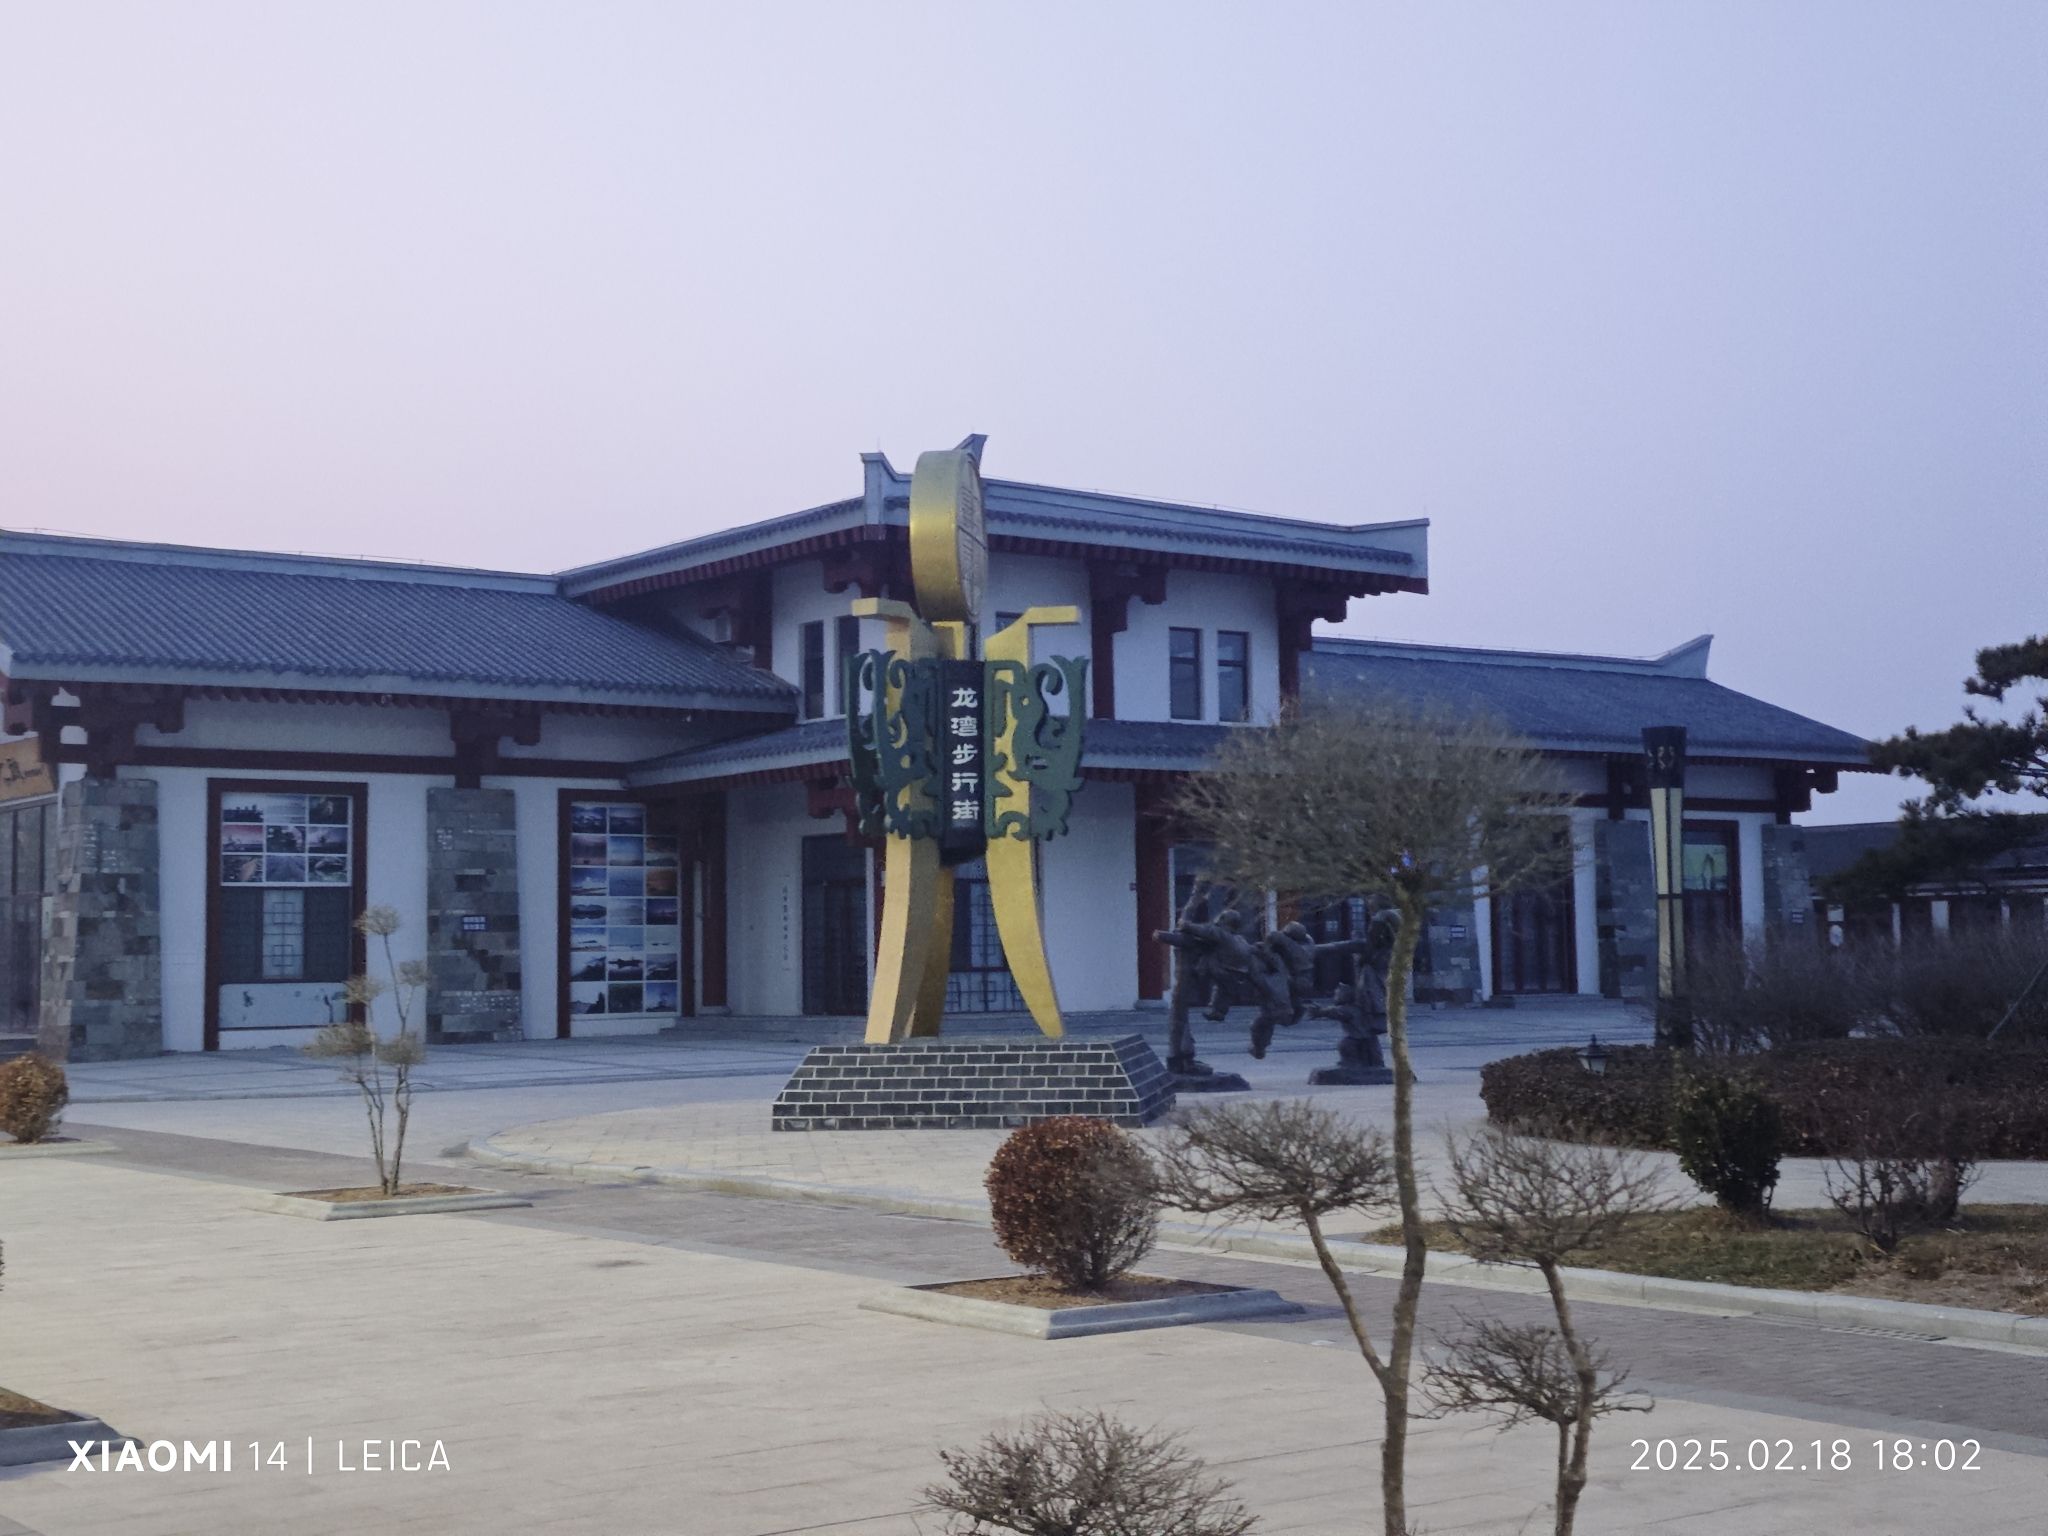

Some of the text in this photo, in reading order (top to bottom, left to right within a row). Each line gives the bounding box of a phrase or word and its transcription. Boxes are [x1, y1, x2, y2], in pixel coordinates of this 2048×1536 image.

[950, 687, 980, 820] 龙湾步行街
